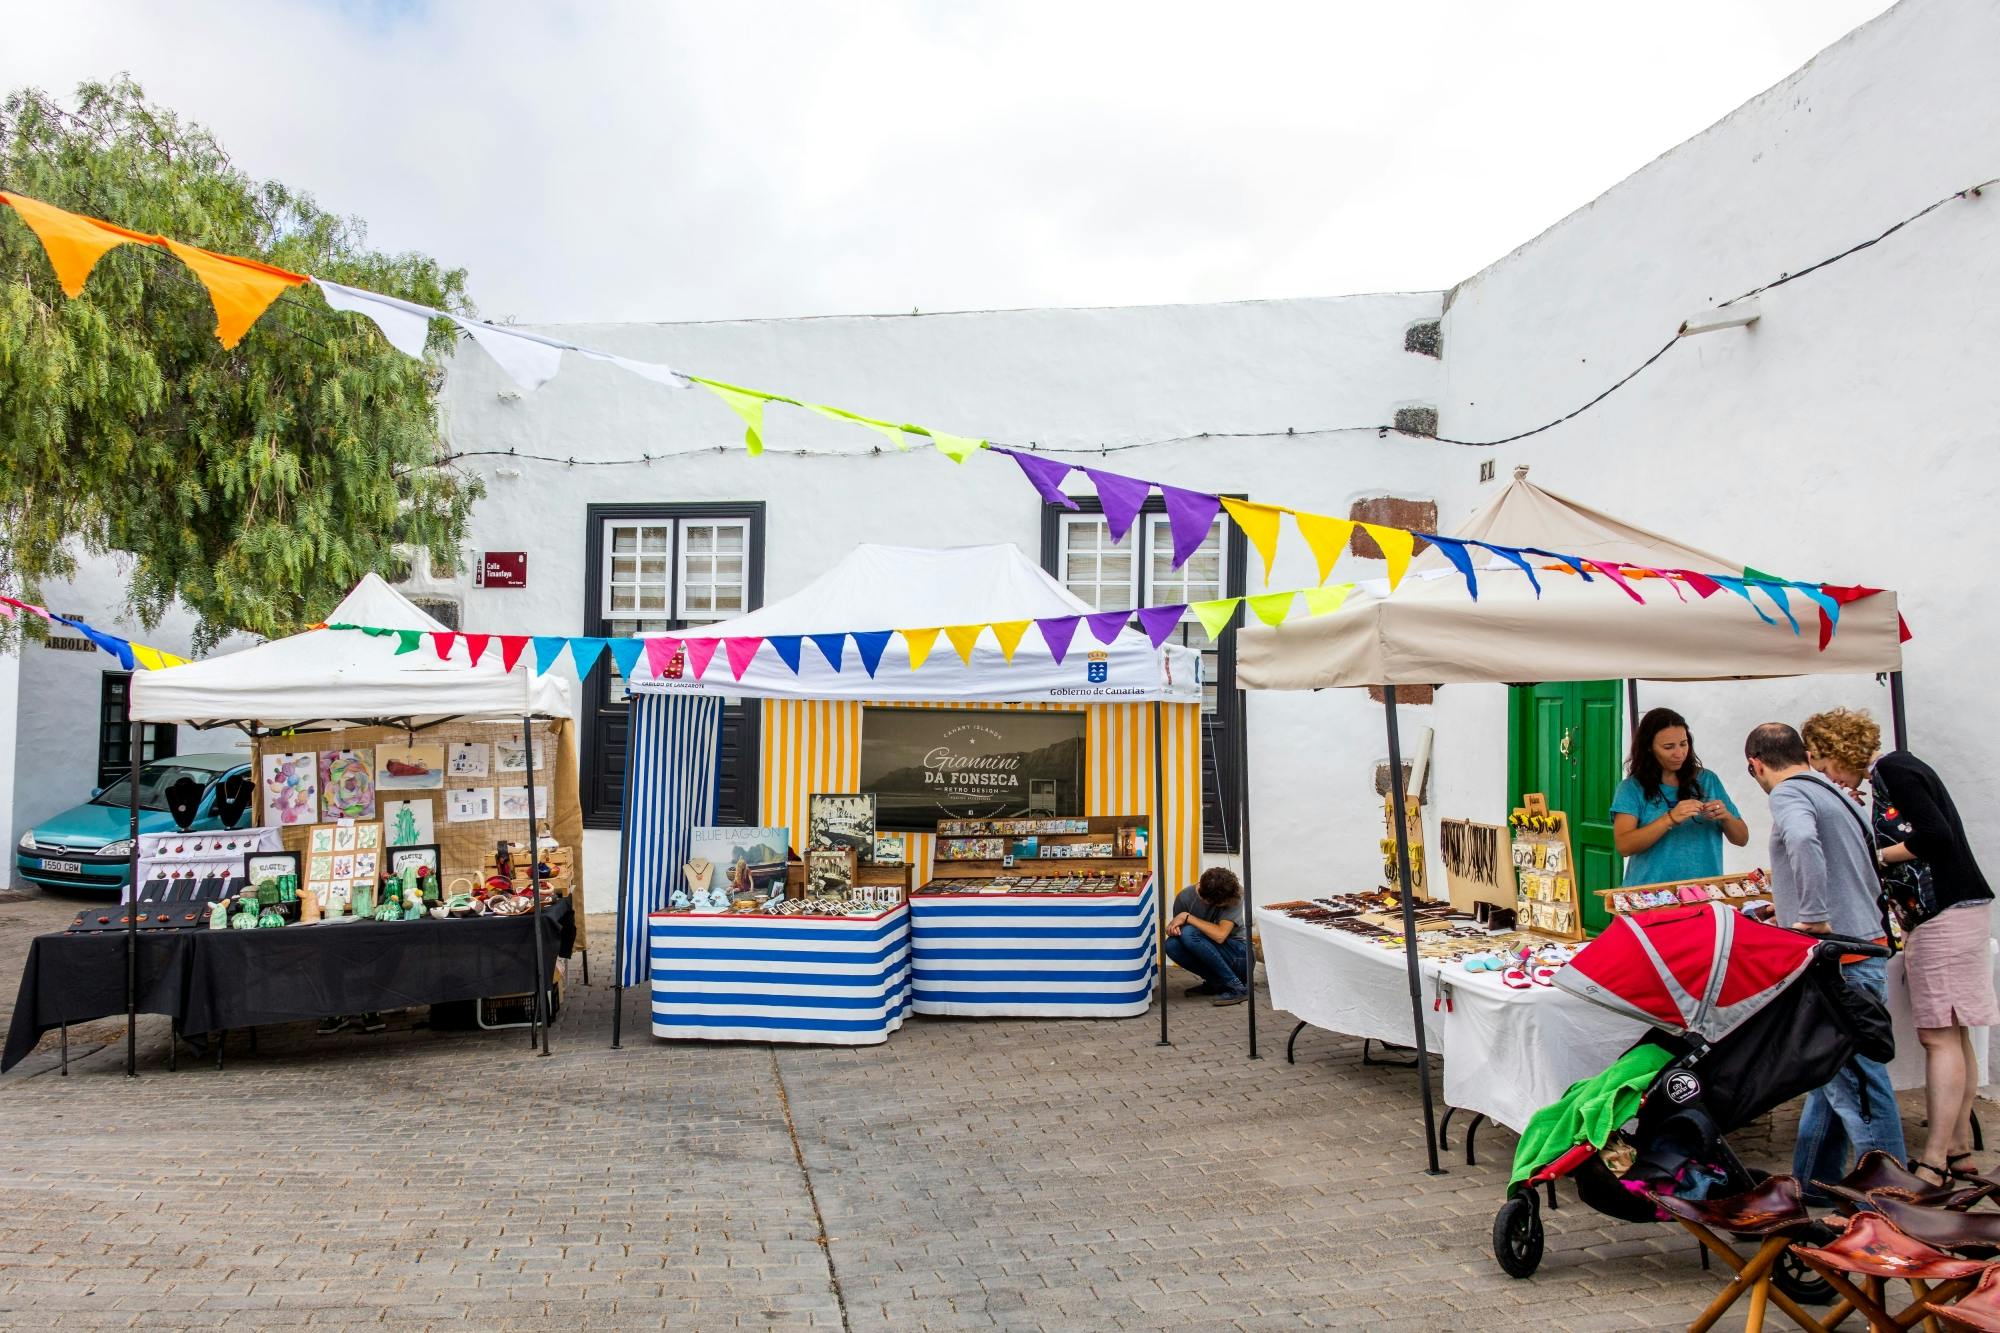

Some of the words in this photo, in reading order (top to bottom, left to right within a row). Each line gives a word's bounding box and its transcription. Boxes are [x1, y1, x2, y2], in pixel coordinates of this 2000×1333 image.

[1480, 460, 1495, 482] EL
[486, 562, 500, 570] Calle
[486, 570, 513, 579] Timanfaya
[1050, 687, 1092, 696] Gobierno
[1093, 687, 1104, 695] de
[1105, 686, 1145, 696] Canarias
[943, 724, 971, 738] CANARY
[973, 724, 1002, 740] ISLANDS
[923, 746, 1021, 773] Giannini
[924, 771, 945, 784] DA
[950, 772, 1019, 787] FONSECA
[695, 829, 721, 842] BLUE
[725, 826, 781, 840] LAGOON
[45, 860, 62, 871] 1550
